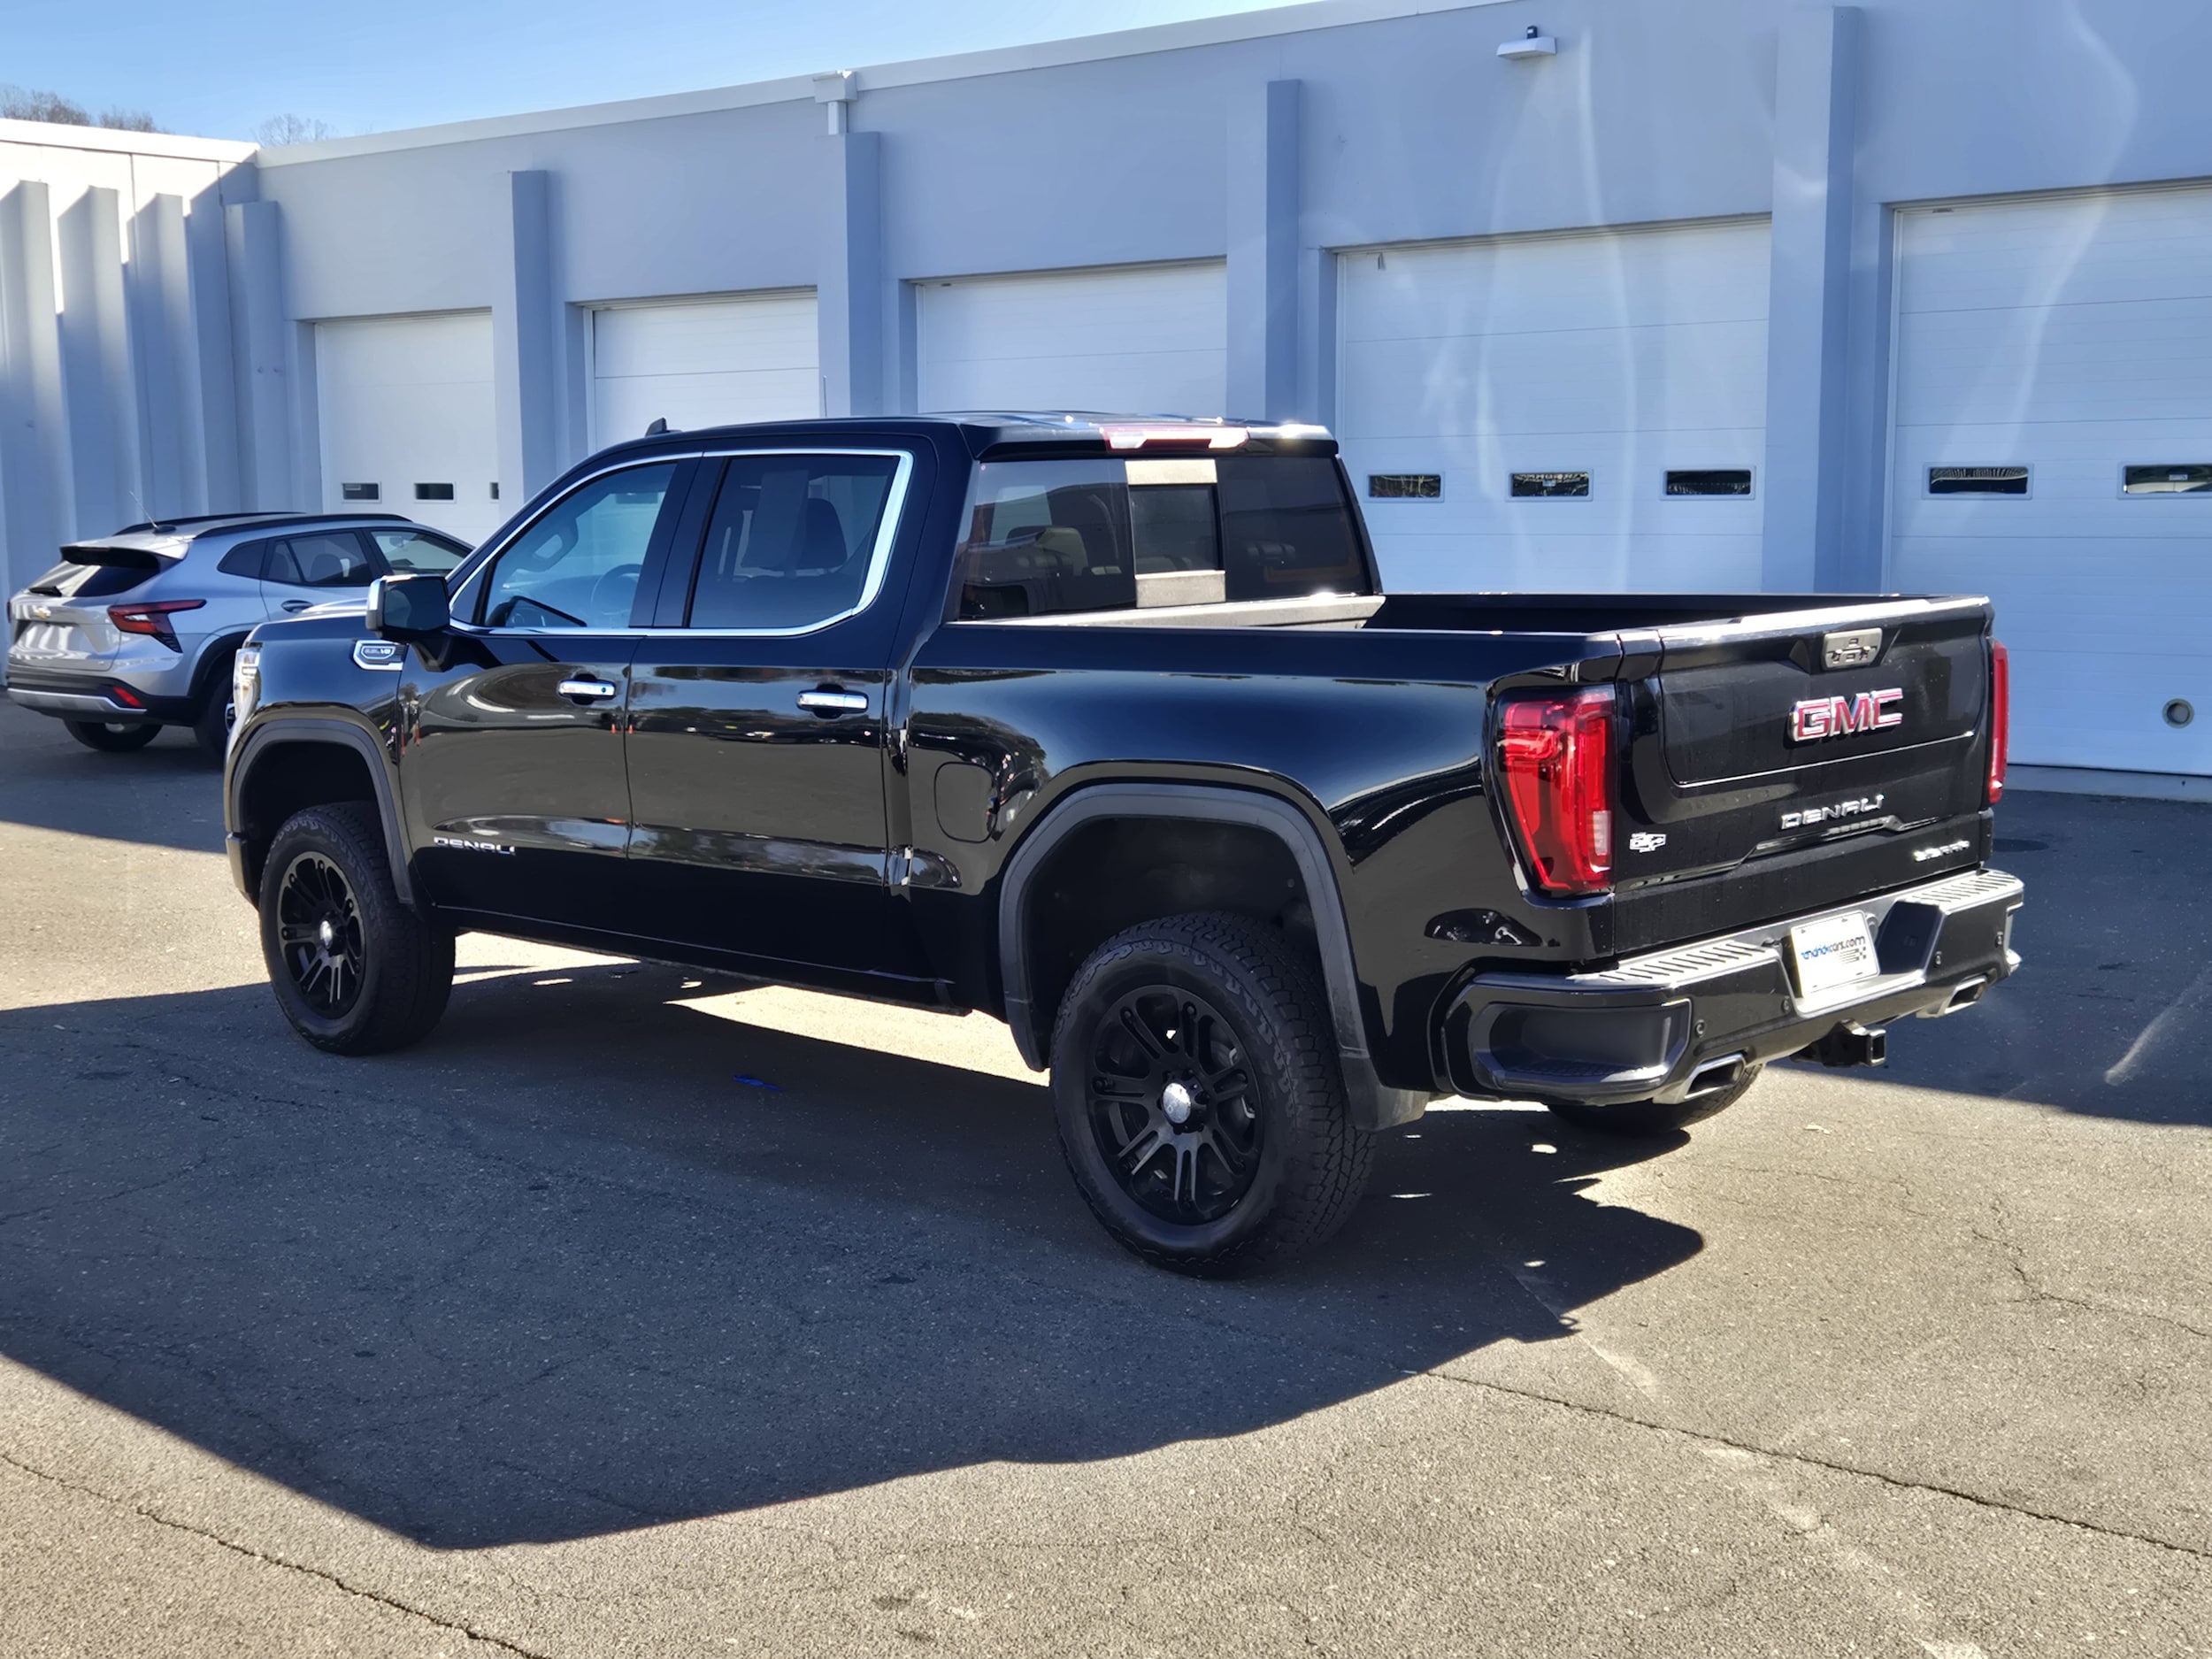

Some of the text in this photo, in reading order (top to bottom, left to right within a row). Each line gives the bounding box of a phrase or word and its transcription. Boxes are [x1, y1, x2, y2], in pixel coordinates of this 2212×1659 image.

[1789, 687, 1903, 741] GMC
[1780, 794, 1885, 830] DENALI
[434, 836, 516, 856] DENALI
